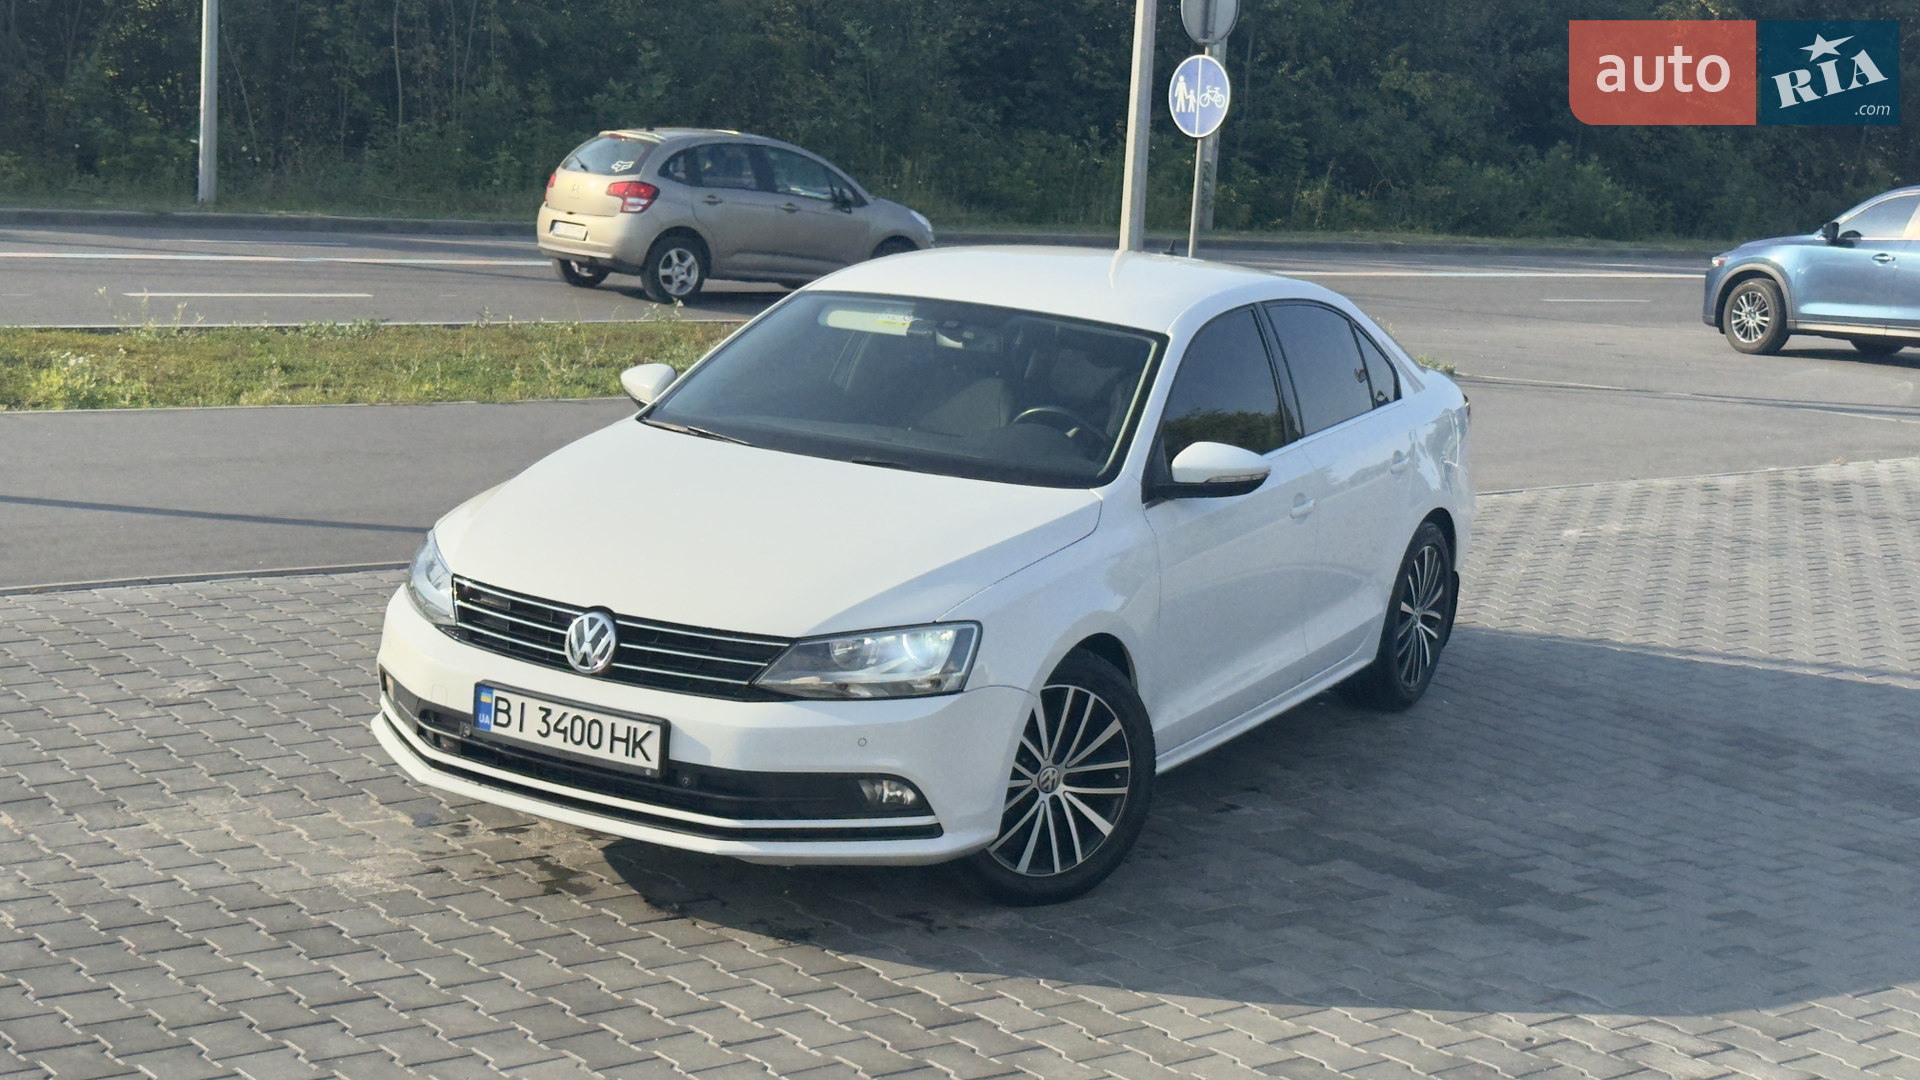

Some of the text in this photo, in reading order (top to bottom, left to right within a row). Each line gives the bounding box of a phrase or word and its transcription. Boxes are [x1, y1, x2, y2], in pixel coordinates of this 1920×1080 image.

[478, 713, 491, 725] UA
[493, 695, 653, 762] BI 3400 HK
